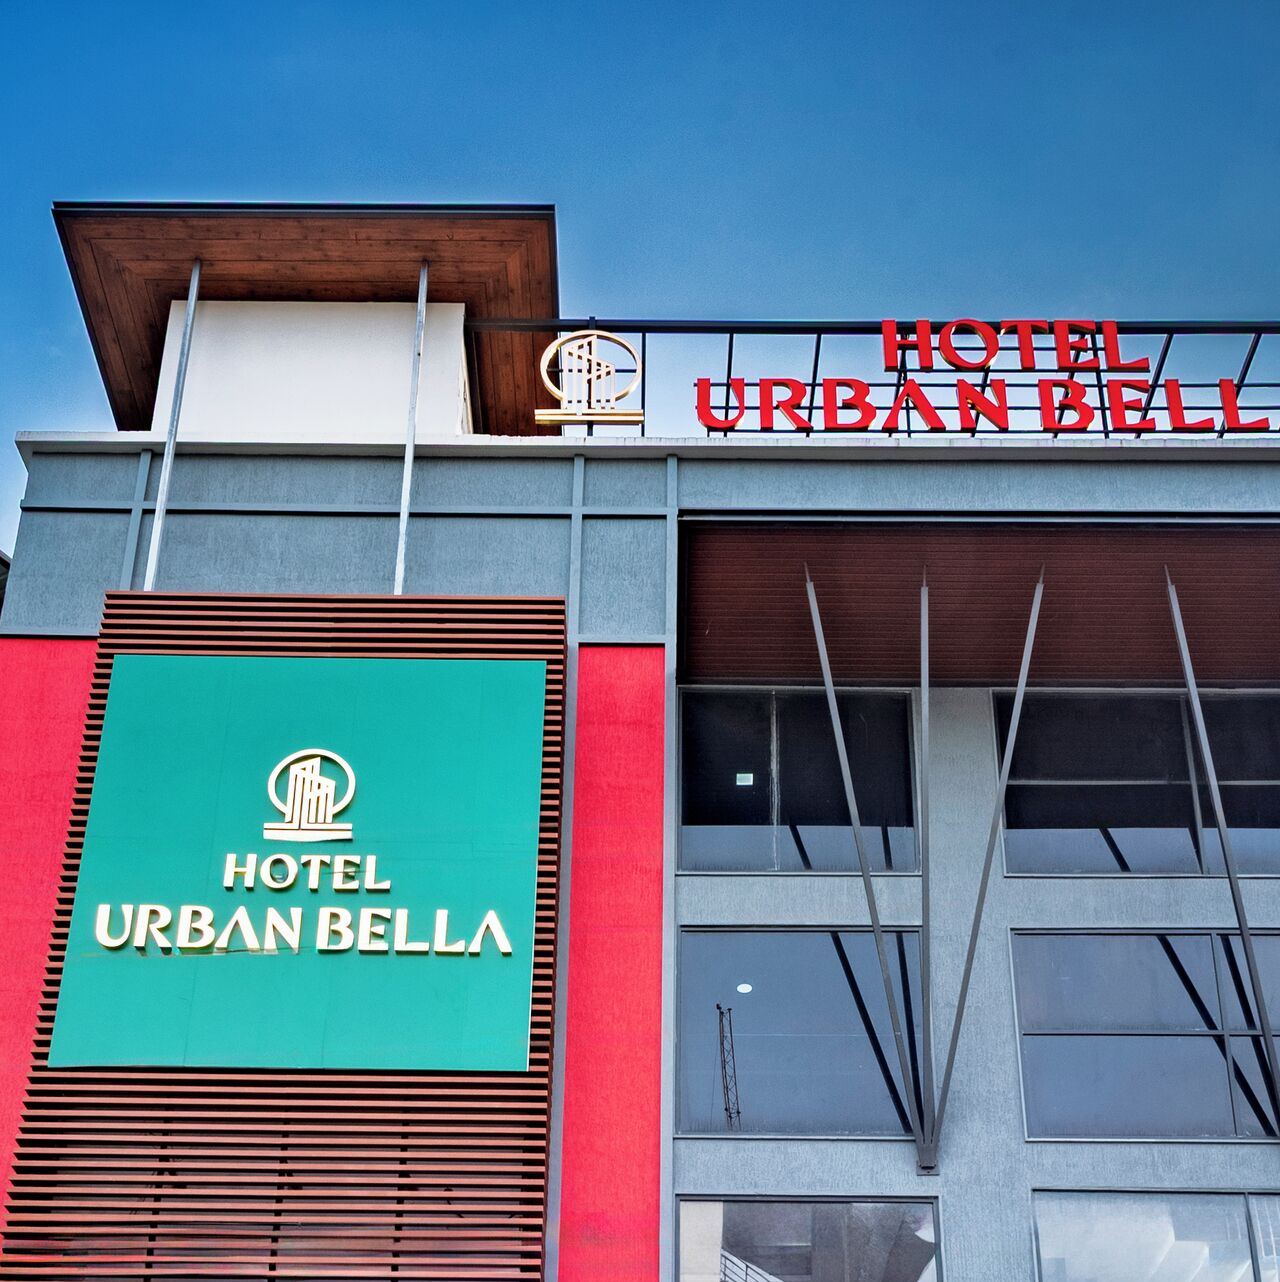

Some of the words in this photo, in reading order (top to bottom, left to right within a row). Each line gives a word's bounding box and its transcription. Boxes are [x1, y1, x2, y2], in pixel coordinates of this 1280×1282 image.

[882, 318, 1150, 373] HOTEL
[694, 376, 1010, 434] URBAN
[223, 852, 391, 892] HOTEL
[94, 903, 303, 955] URBAN
[316, 906, 513, 957] BELLA
